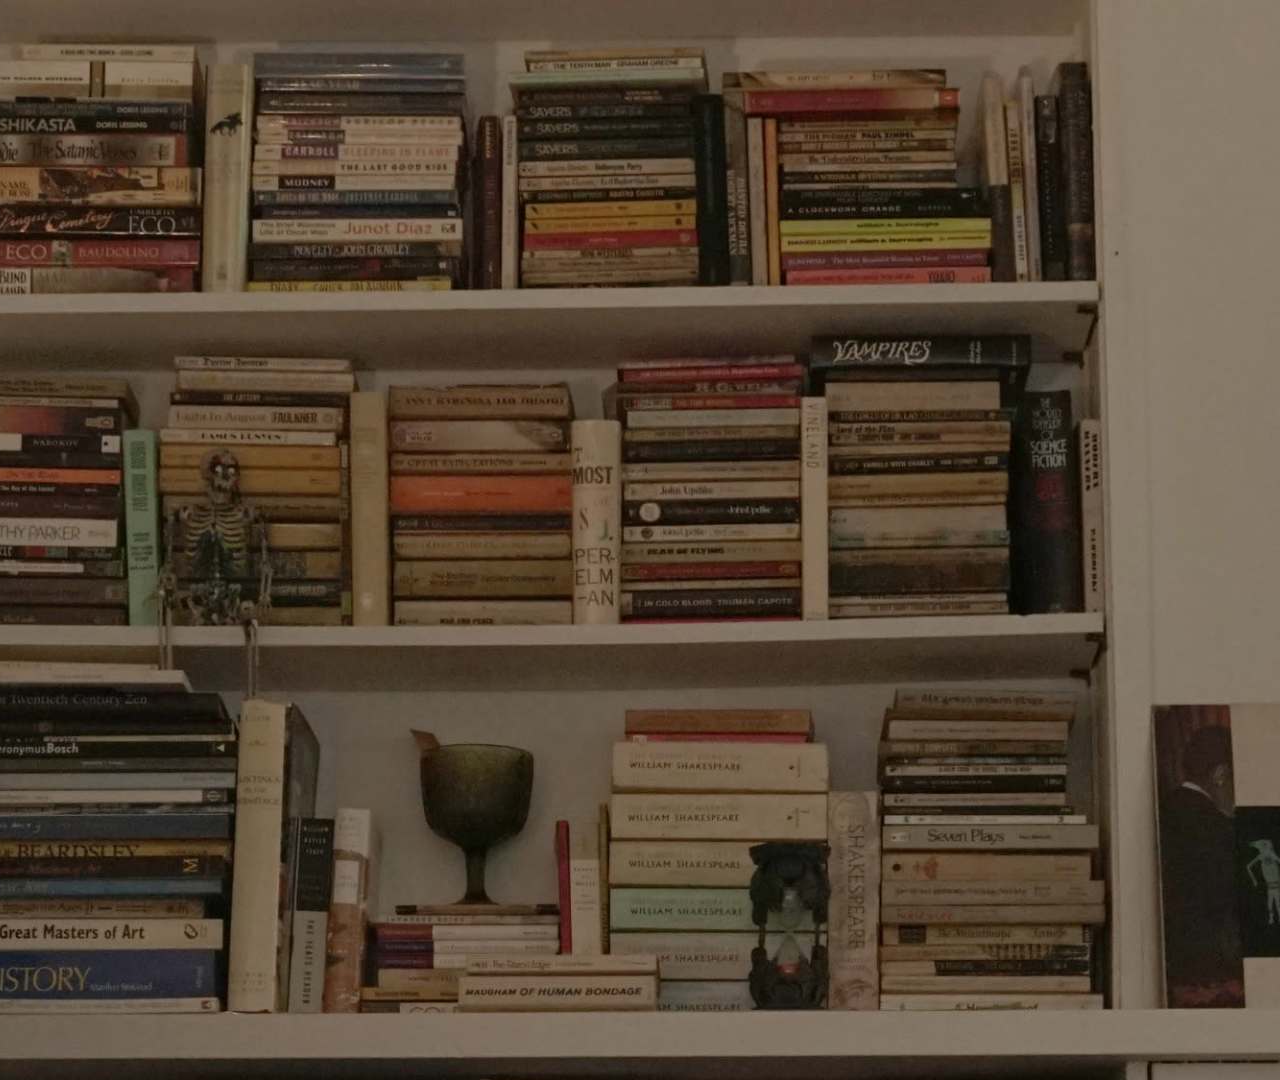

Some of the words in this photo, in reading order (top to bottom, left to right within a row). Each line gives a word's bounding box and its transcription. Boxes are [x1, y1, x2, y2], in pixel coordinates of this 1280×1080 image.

[528, 106, 573, 119] SAYERS
[0, 117, 77, 133] SHIKASTA
[128, 217, 177, 234] ECO
[343, 221, 390, 236] Junot
[5, 243, 48, 260] ECO
[78, 246, 160, 259] BAUDOLINO
[832, 340, 933, 366] VAMPIRES
[805, 403, 820, 469] VINELAND
[1030, 439, 1068, 454] SCIENCE
[1031, 454, 1068, 469] FICTION
[572, 466, 614, 486] MOST
[28, 525, 81, 541] PARKER
[655, 599, 680, 608] COLD
[629, 761, 671, 770] WILLIAM
[676, 761, 742, 772] SHAKESPEARE
[627, 813, 670, 822] WILLIAM
[674, 813, 740, 823] SHAKESPEARE
[926, 828, 968, 843] Seven
[970, 828, 1006, 846] Plays
[16, 843, 141, 860] BEARDSLEY
[628, 859, 671, 869] WILLIAM
[675, 859, 741, 870] SHAKESPEARE
[847, 823, 866, 950] SHAKESPEARE
[630, 906, 673, 916] WILLIAM
[676, 907, 743, 917] SHAKESPEARE
[42, 924, 99, 940] Masters
[103, 924, 118, 940] of
[121, 923, 145, 940] Art
[673, 953, 740, 963] SHAKESPEARE
[465, 987, 517, 997] MAUGHAM
[519, 986, 535, 997] OF
[537, 987, 581, 997] HUMAN
[584, 986, 643, 997] BONDAGE
